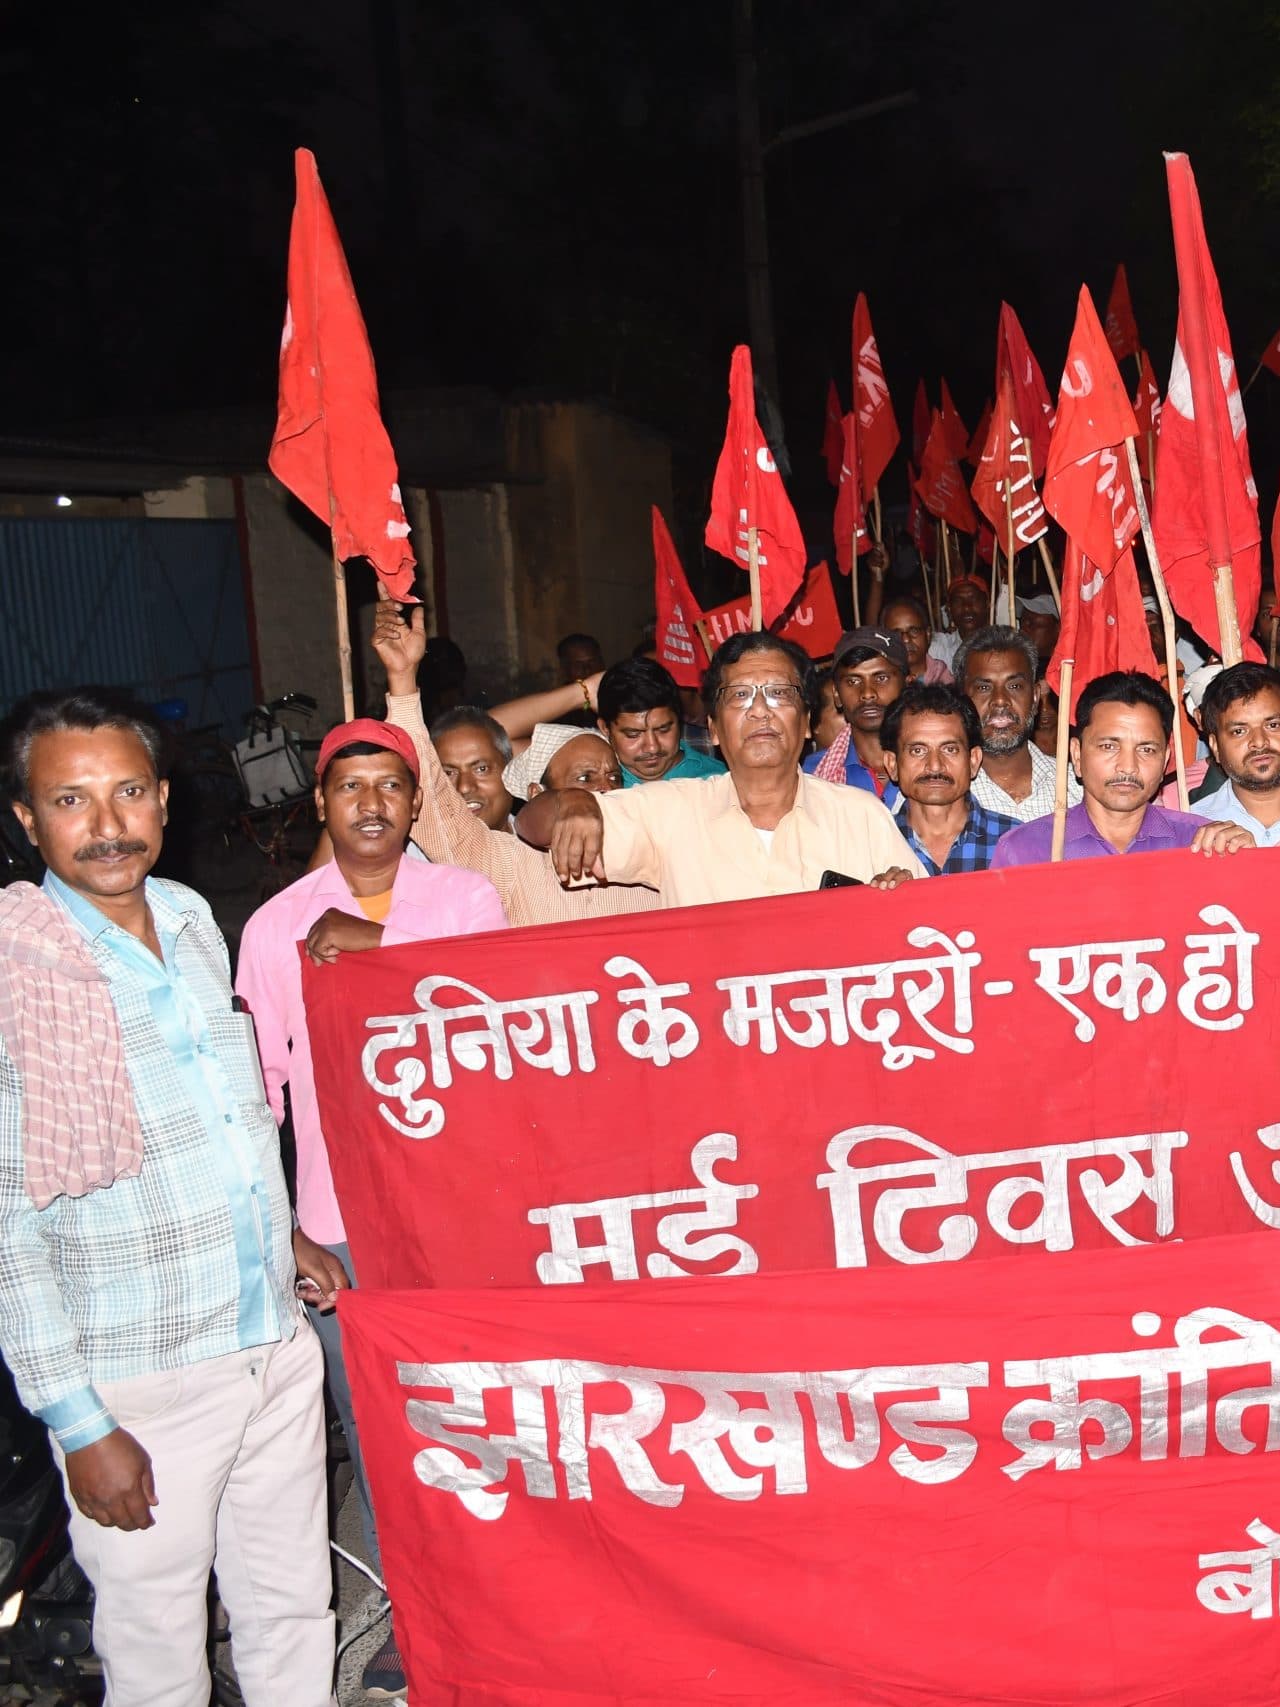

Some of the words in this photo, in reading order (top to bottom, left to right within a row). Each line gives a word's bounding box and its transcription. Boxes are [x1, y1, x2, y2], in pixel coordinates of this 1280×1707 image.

[362, 975, 599, 1139] दुनिया
[604, 956, 700, 1067] के
[1028, 937, 1167, 1043] एक
[1176, 904, 1261, 1032] हो
[395, 1358, 990, 1521] झारखण्ड
